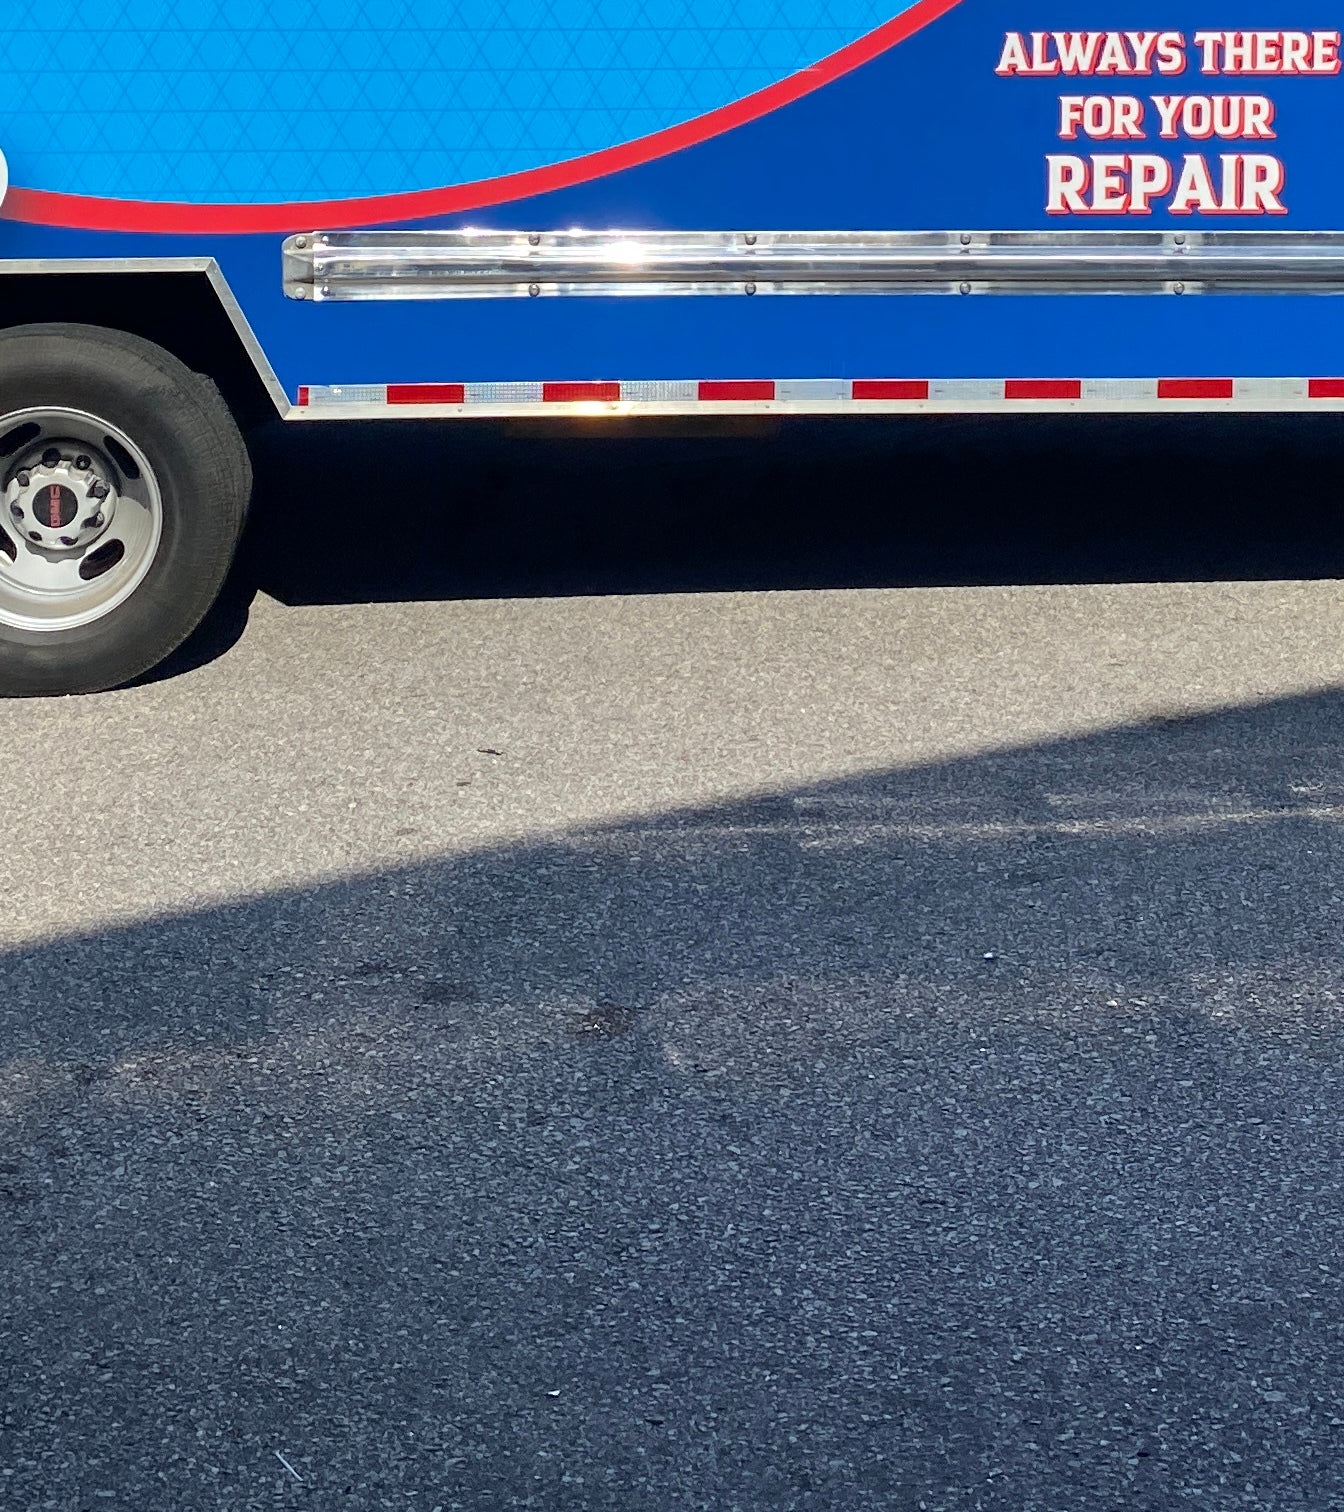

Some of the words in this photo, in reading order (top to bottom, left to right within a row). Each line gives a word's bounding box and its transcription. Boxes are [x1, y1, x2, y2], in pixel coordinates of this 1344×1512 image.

[994, 30, 1187, 76] ALWAYS
[1193, 30, 1343, 76] THERE
[1058, 95, 1147, 141] FOR
[1149, 94, 1278, 140] YOUR
[1044, 152, 1289, 216] REPAIR
